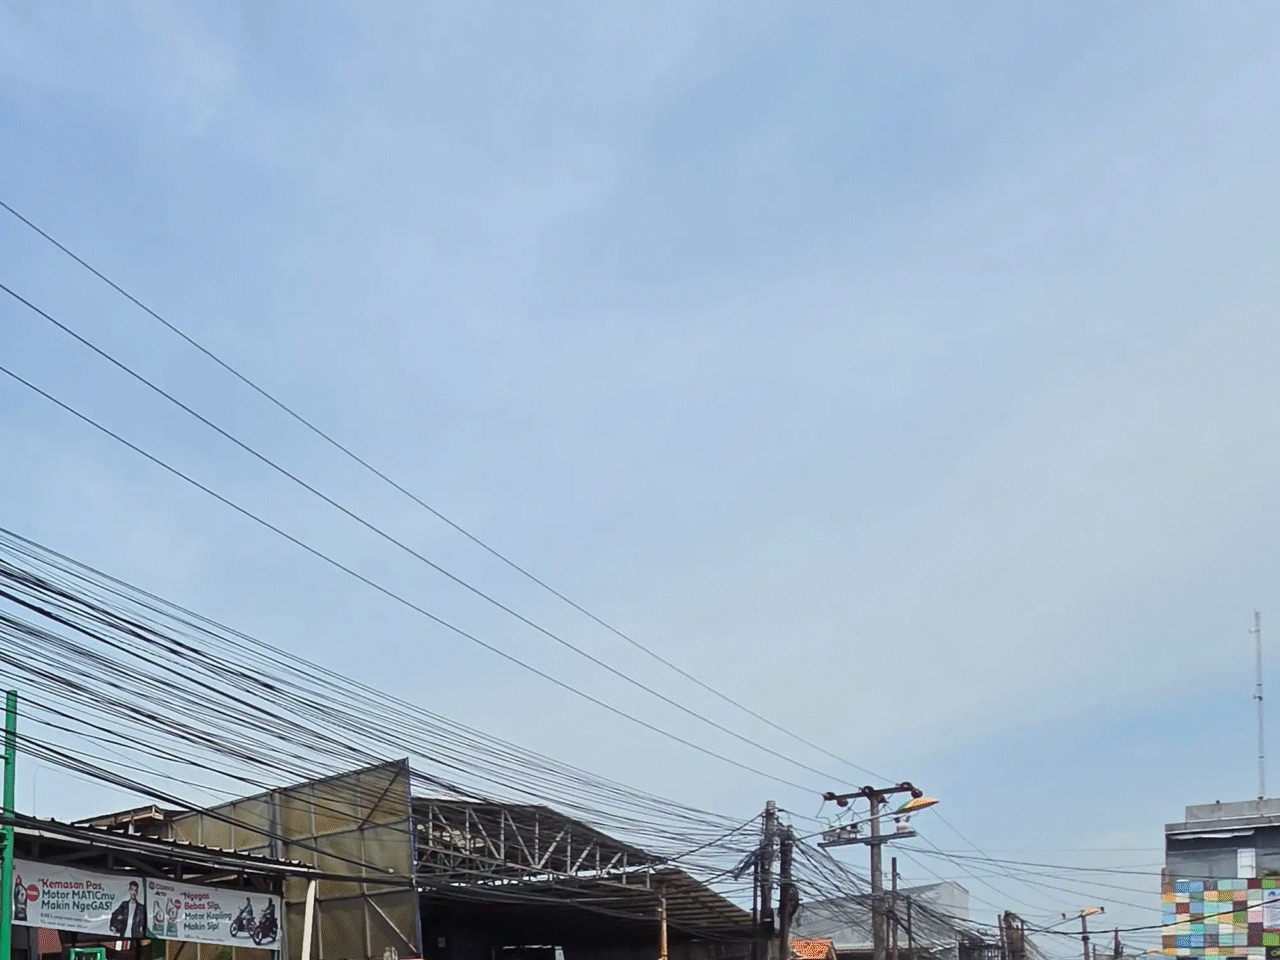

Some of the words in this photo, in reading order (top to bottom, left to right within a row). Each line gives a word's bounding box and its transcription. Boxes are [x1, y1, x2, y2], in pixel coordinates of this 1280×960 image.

[85, 880, 105, 892] Pas,
[41, 890, 71, 901] Motor
[71, 890, 116, 901] MATICmu
[40, 899, 71, 911] Makin
[72, 900, 113, 913] NgeGAS!
[184, 901, 206, 910] Bebas
[184, 911, 205, 920] Motor
[206, 912, 232, 921] Kopling
[183, 922, 206, 931] Makin
